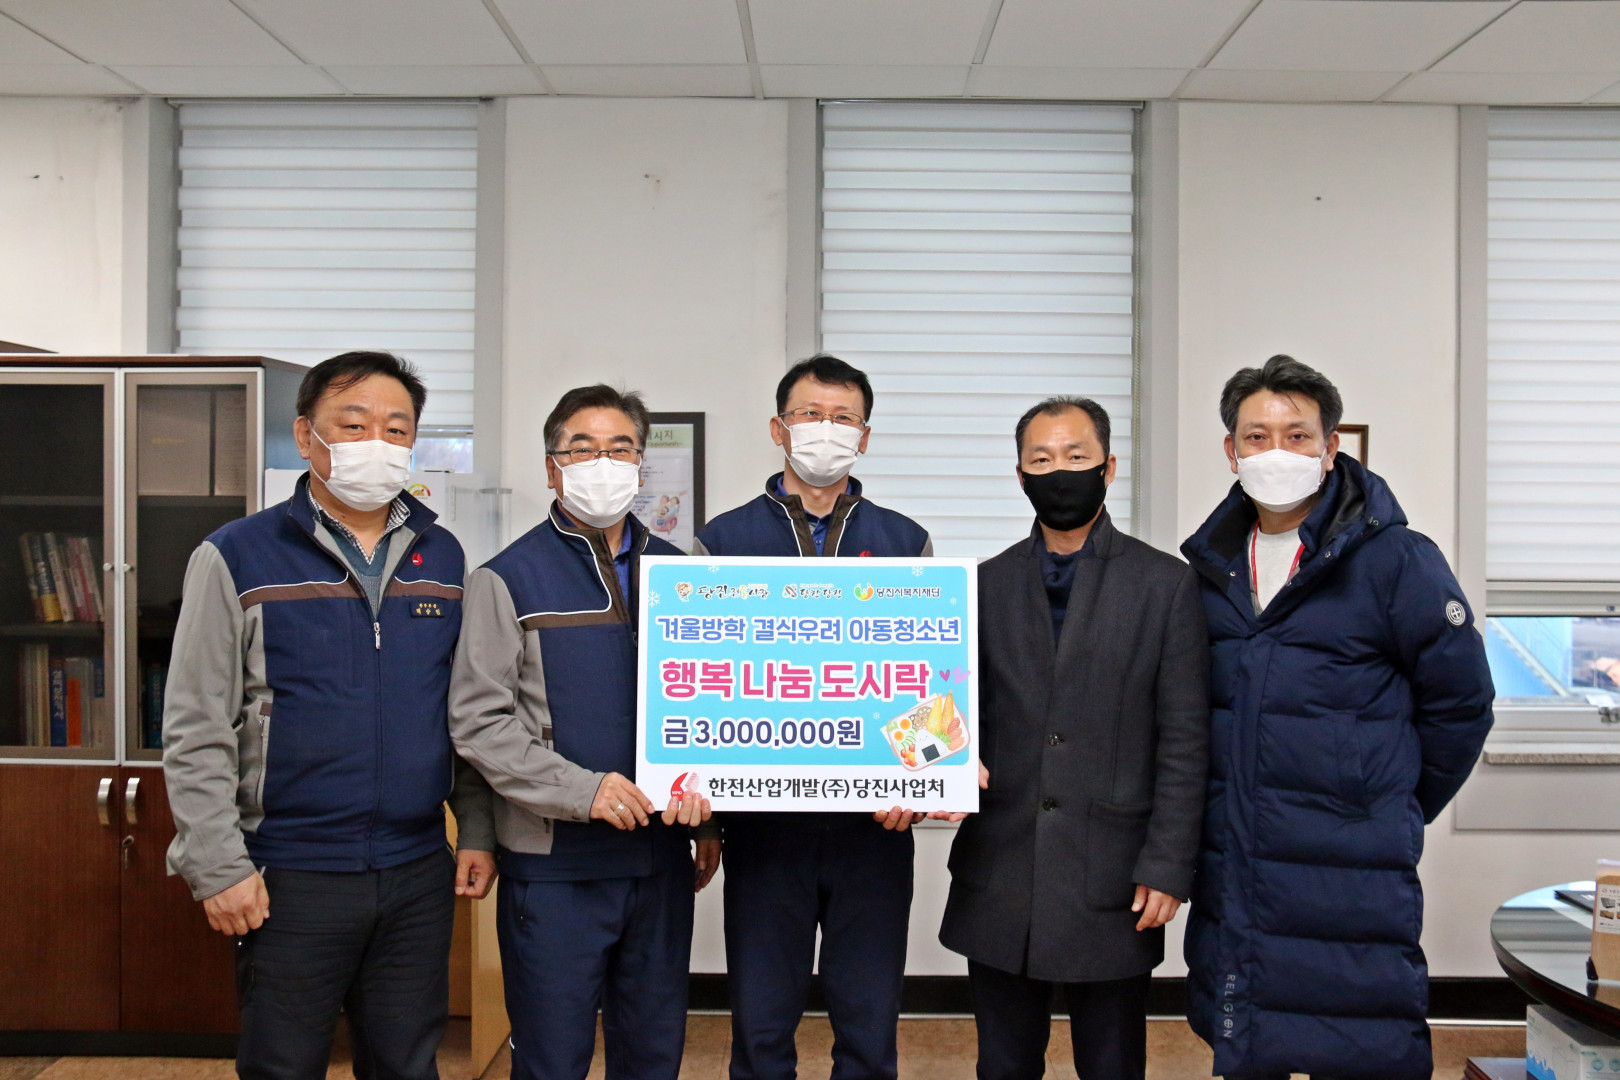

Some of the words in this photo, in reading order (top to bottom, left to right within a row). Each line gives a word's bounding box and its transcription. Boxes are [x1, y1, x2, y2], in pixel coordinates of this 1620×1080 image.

[876, 587, 941, 598] 당진시복지재단
[658, 617, 746, 642] 겨울방학
[754, 617, 841, 642] 결식우려
[849, 618, 960, 643] 아동청소년
[662, 660, 734, 699] 행복
[743, 662, 813, 699] 나눔
[821, 663, 931, 700] 도시락
[664, 718, 689, 747] 금
[695, 719, 862, 748] 3,000,000원
[1223, 974, 1236, 1038] RELIGION
